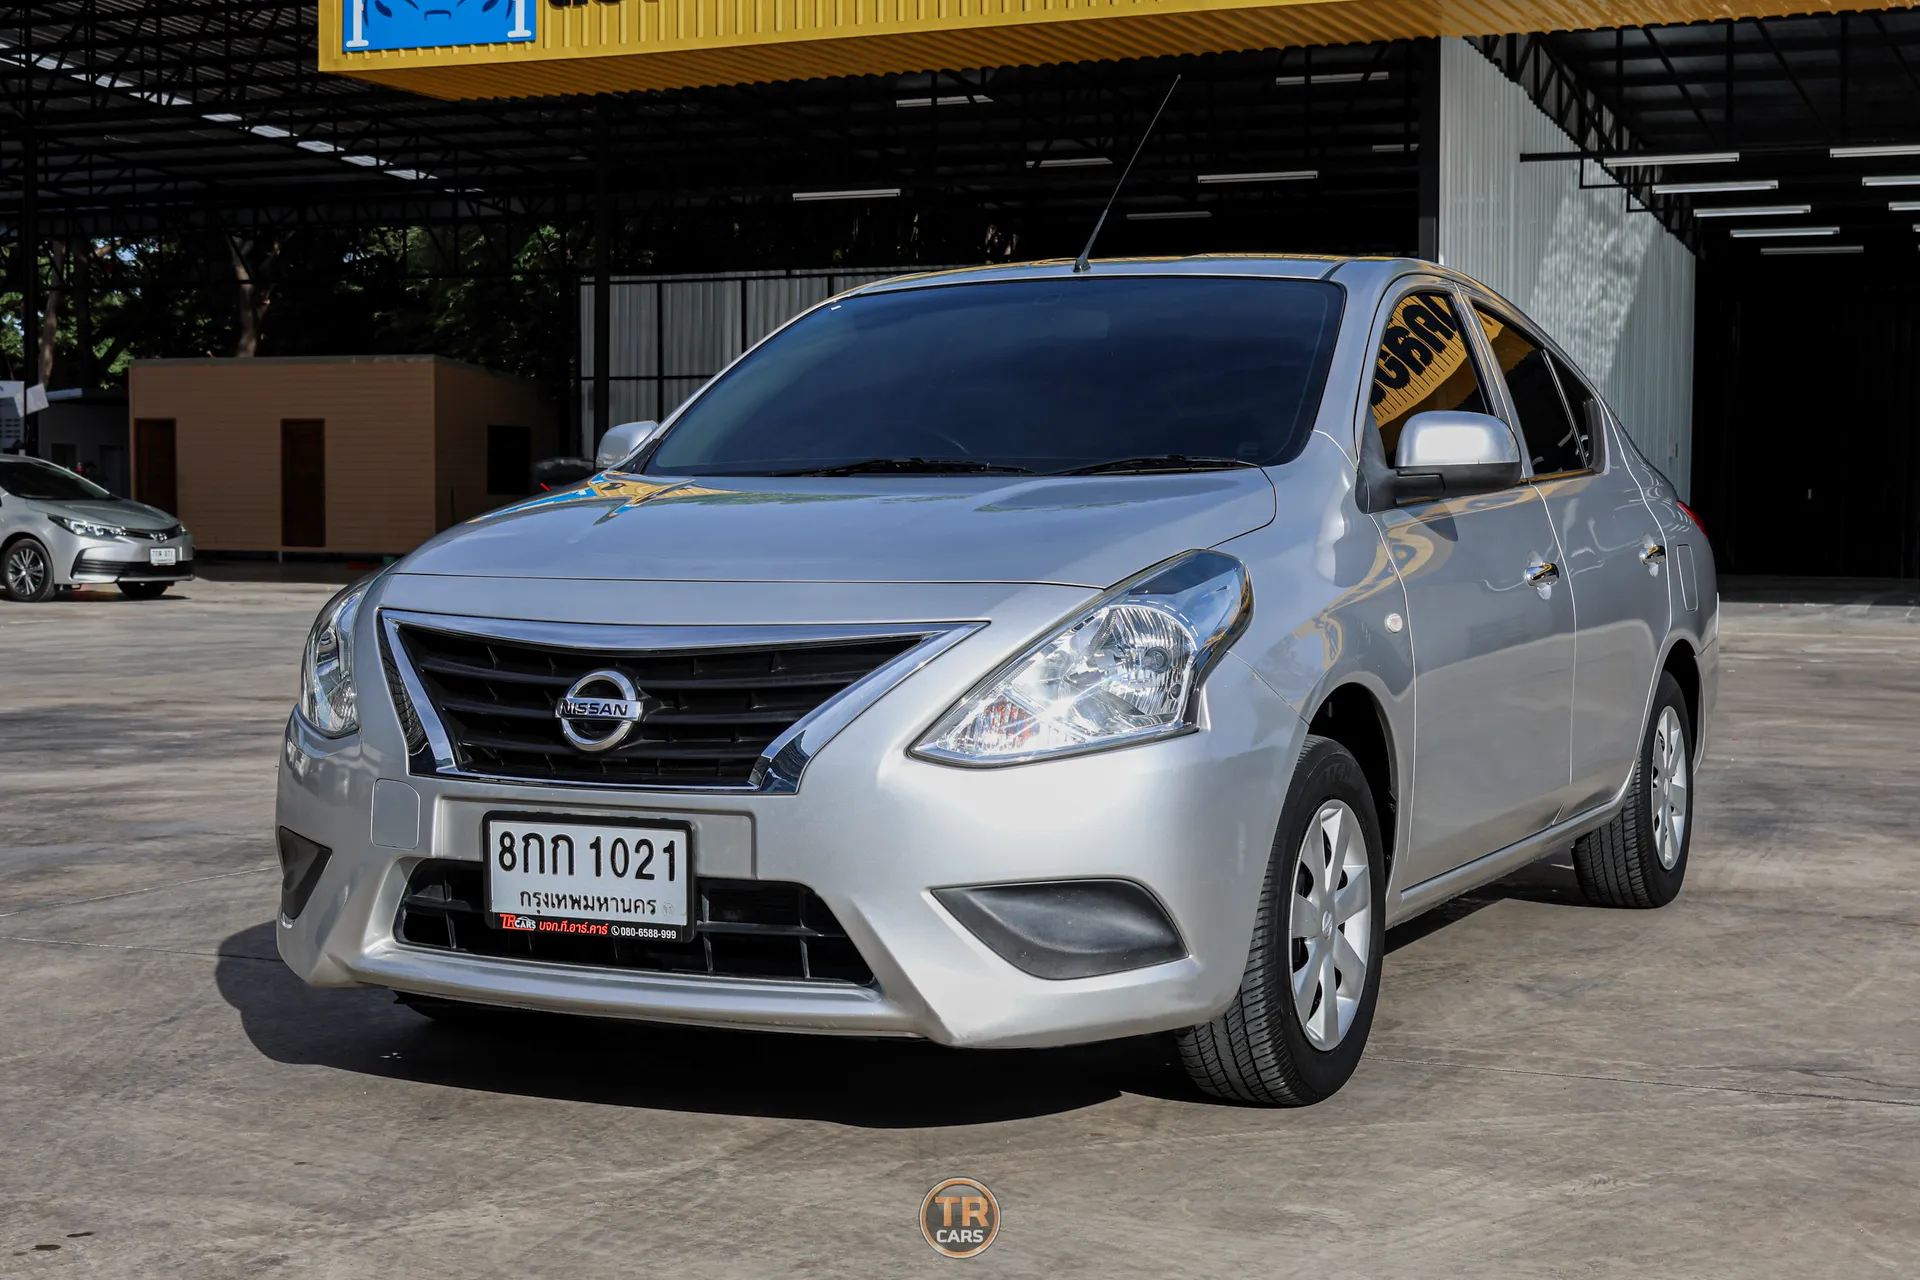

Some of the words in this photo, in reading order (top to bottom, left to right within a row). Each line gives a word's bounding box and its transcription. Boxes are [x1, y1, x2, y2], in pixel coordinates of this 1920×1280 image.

[560, 702, 628, 717] NISSAN
[498, 830, 575, 877] 8กก
[589, 835, 676, 882] 1021
[519, 890, 657, 915] กรุงเทพมหานคร
[620, 927, 677, 940] 080-6588-999
